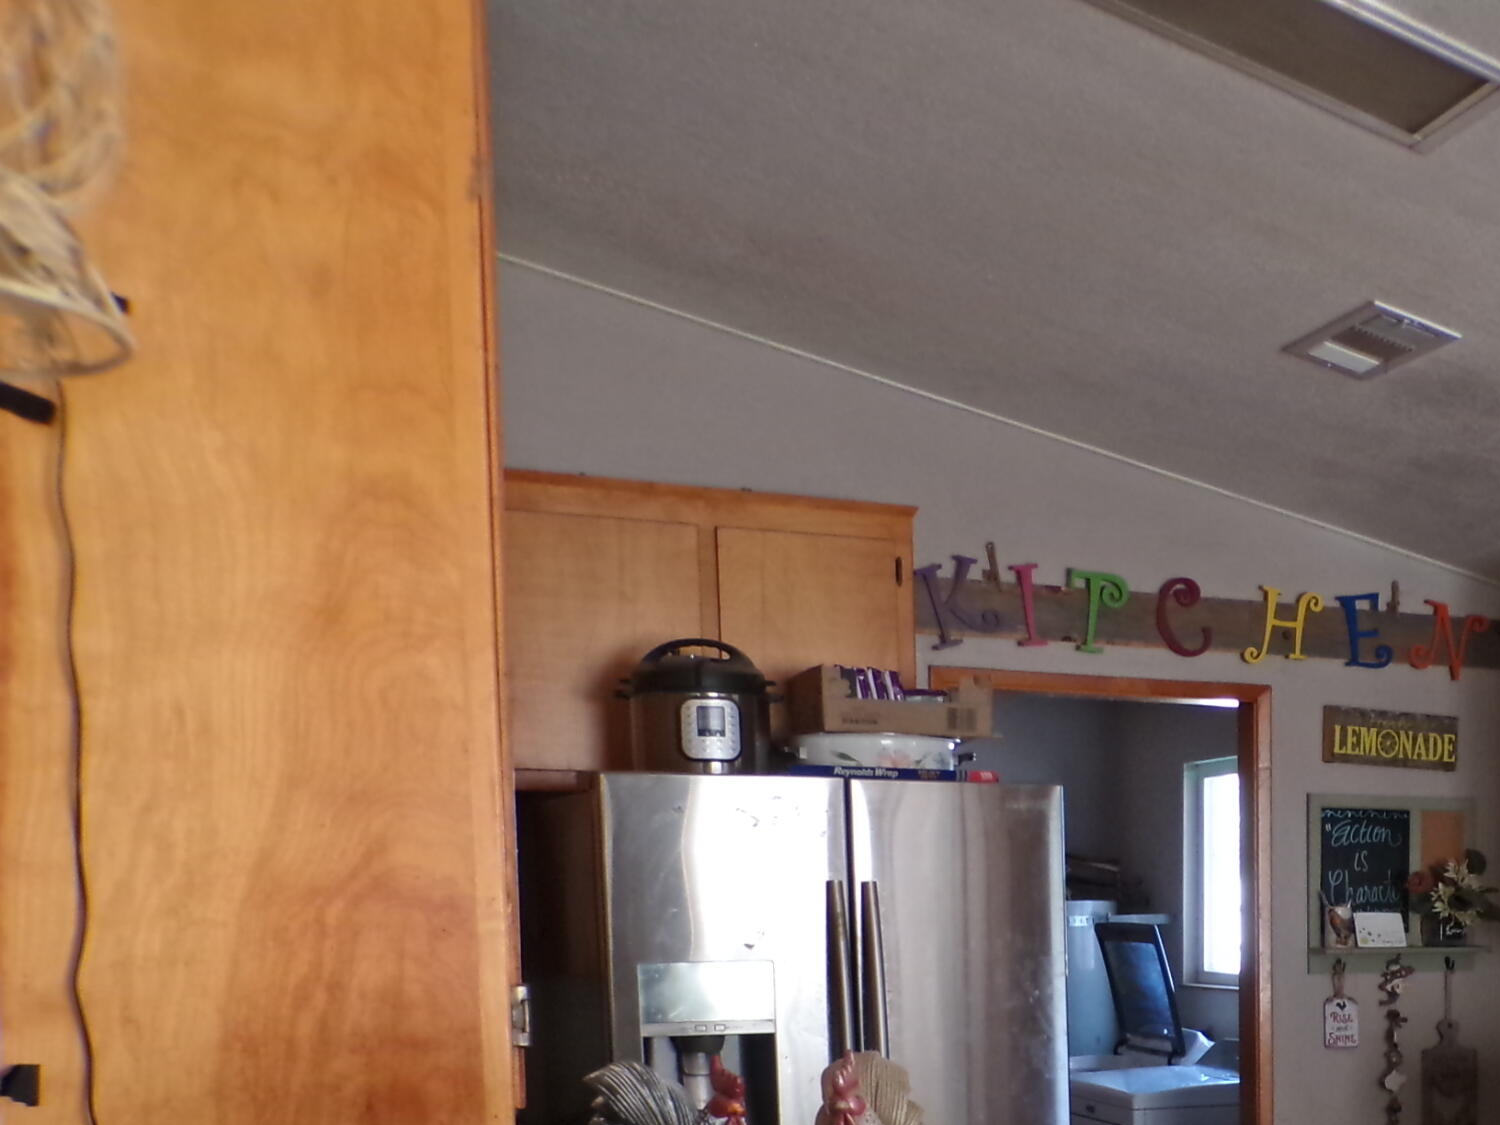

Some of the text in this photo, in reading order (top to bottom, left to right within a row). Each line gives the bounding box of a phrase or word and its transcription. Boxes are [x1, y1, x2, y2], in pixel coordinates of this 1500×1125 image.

[914, 554, 1489, 682] KITCHEN
[1333, 724, 1456, 763] LEMONADE
[833, 766, 899, 779] Reynolds Wrap
